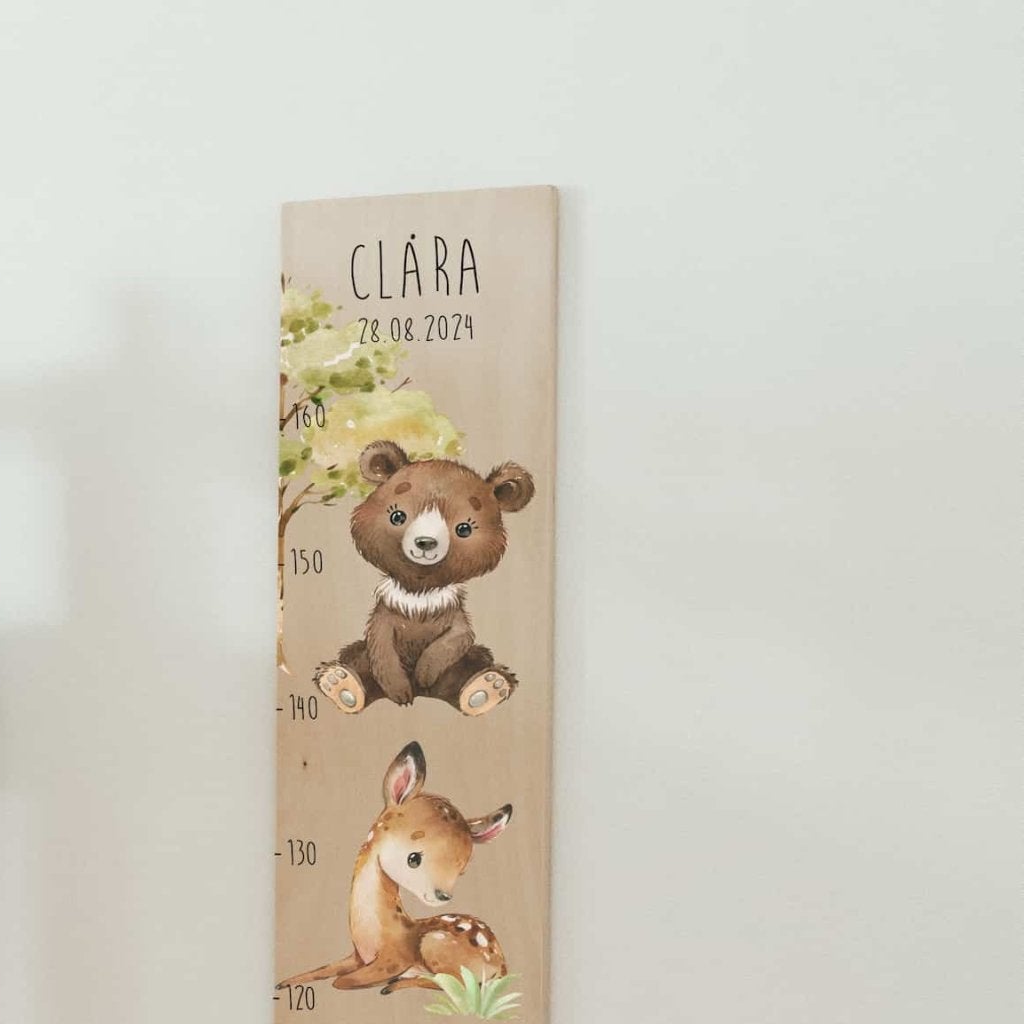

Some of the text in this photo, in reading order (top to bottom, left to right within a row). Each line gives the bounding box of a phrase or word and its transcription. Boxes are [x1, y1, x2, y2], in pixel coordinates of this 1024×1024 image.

[358, 313, 473, 345] 28.08.2024
[292, 402, 325, 429] 160
[291, 548, 323, 575] 150
[289, 694, 319, 720] 140
[288, 840, 317, 866] 130
[286, 984, 316, 1011] 120
